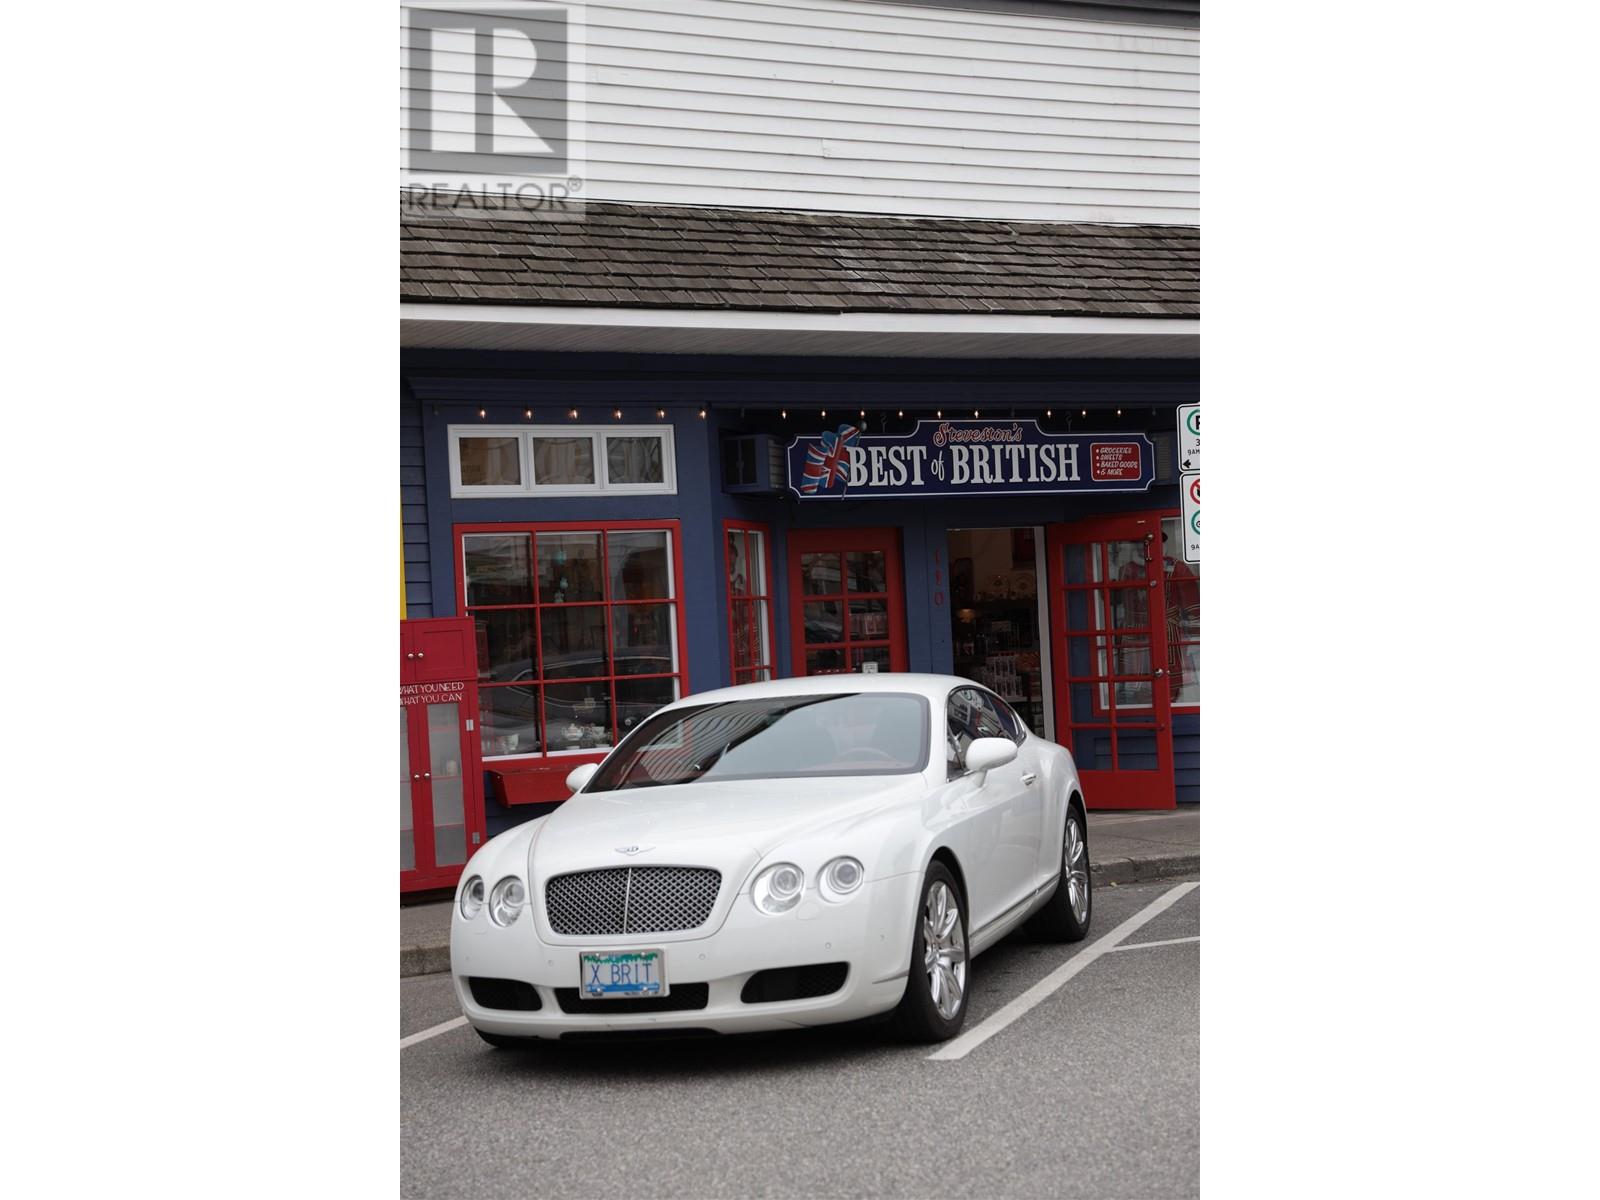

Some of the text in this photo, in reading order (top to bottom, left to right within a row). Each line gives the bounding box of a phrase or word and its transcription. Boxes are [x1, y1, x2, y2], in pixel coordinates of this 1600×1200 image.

[933, 422, 1023, 447] Steveston's
[846, 443, 1081, 487] BEST of BRITISH
[420, 683, 438, 693] YOU
[439, 682, 464, 691] NEED
[420, 694, 439, 703] YOU
[441, 693, 462, 702] CAN
[591, 963, 652, 984] X BRIT
